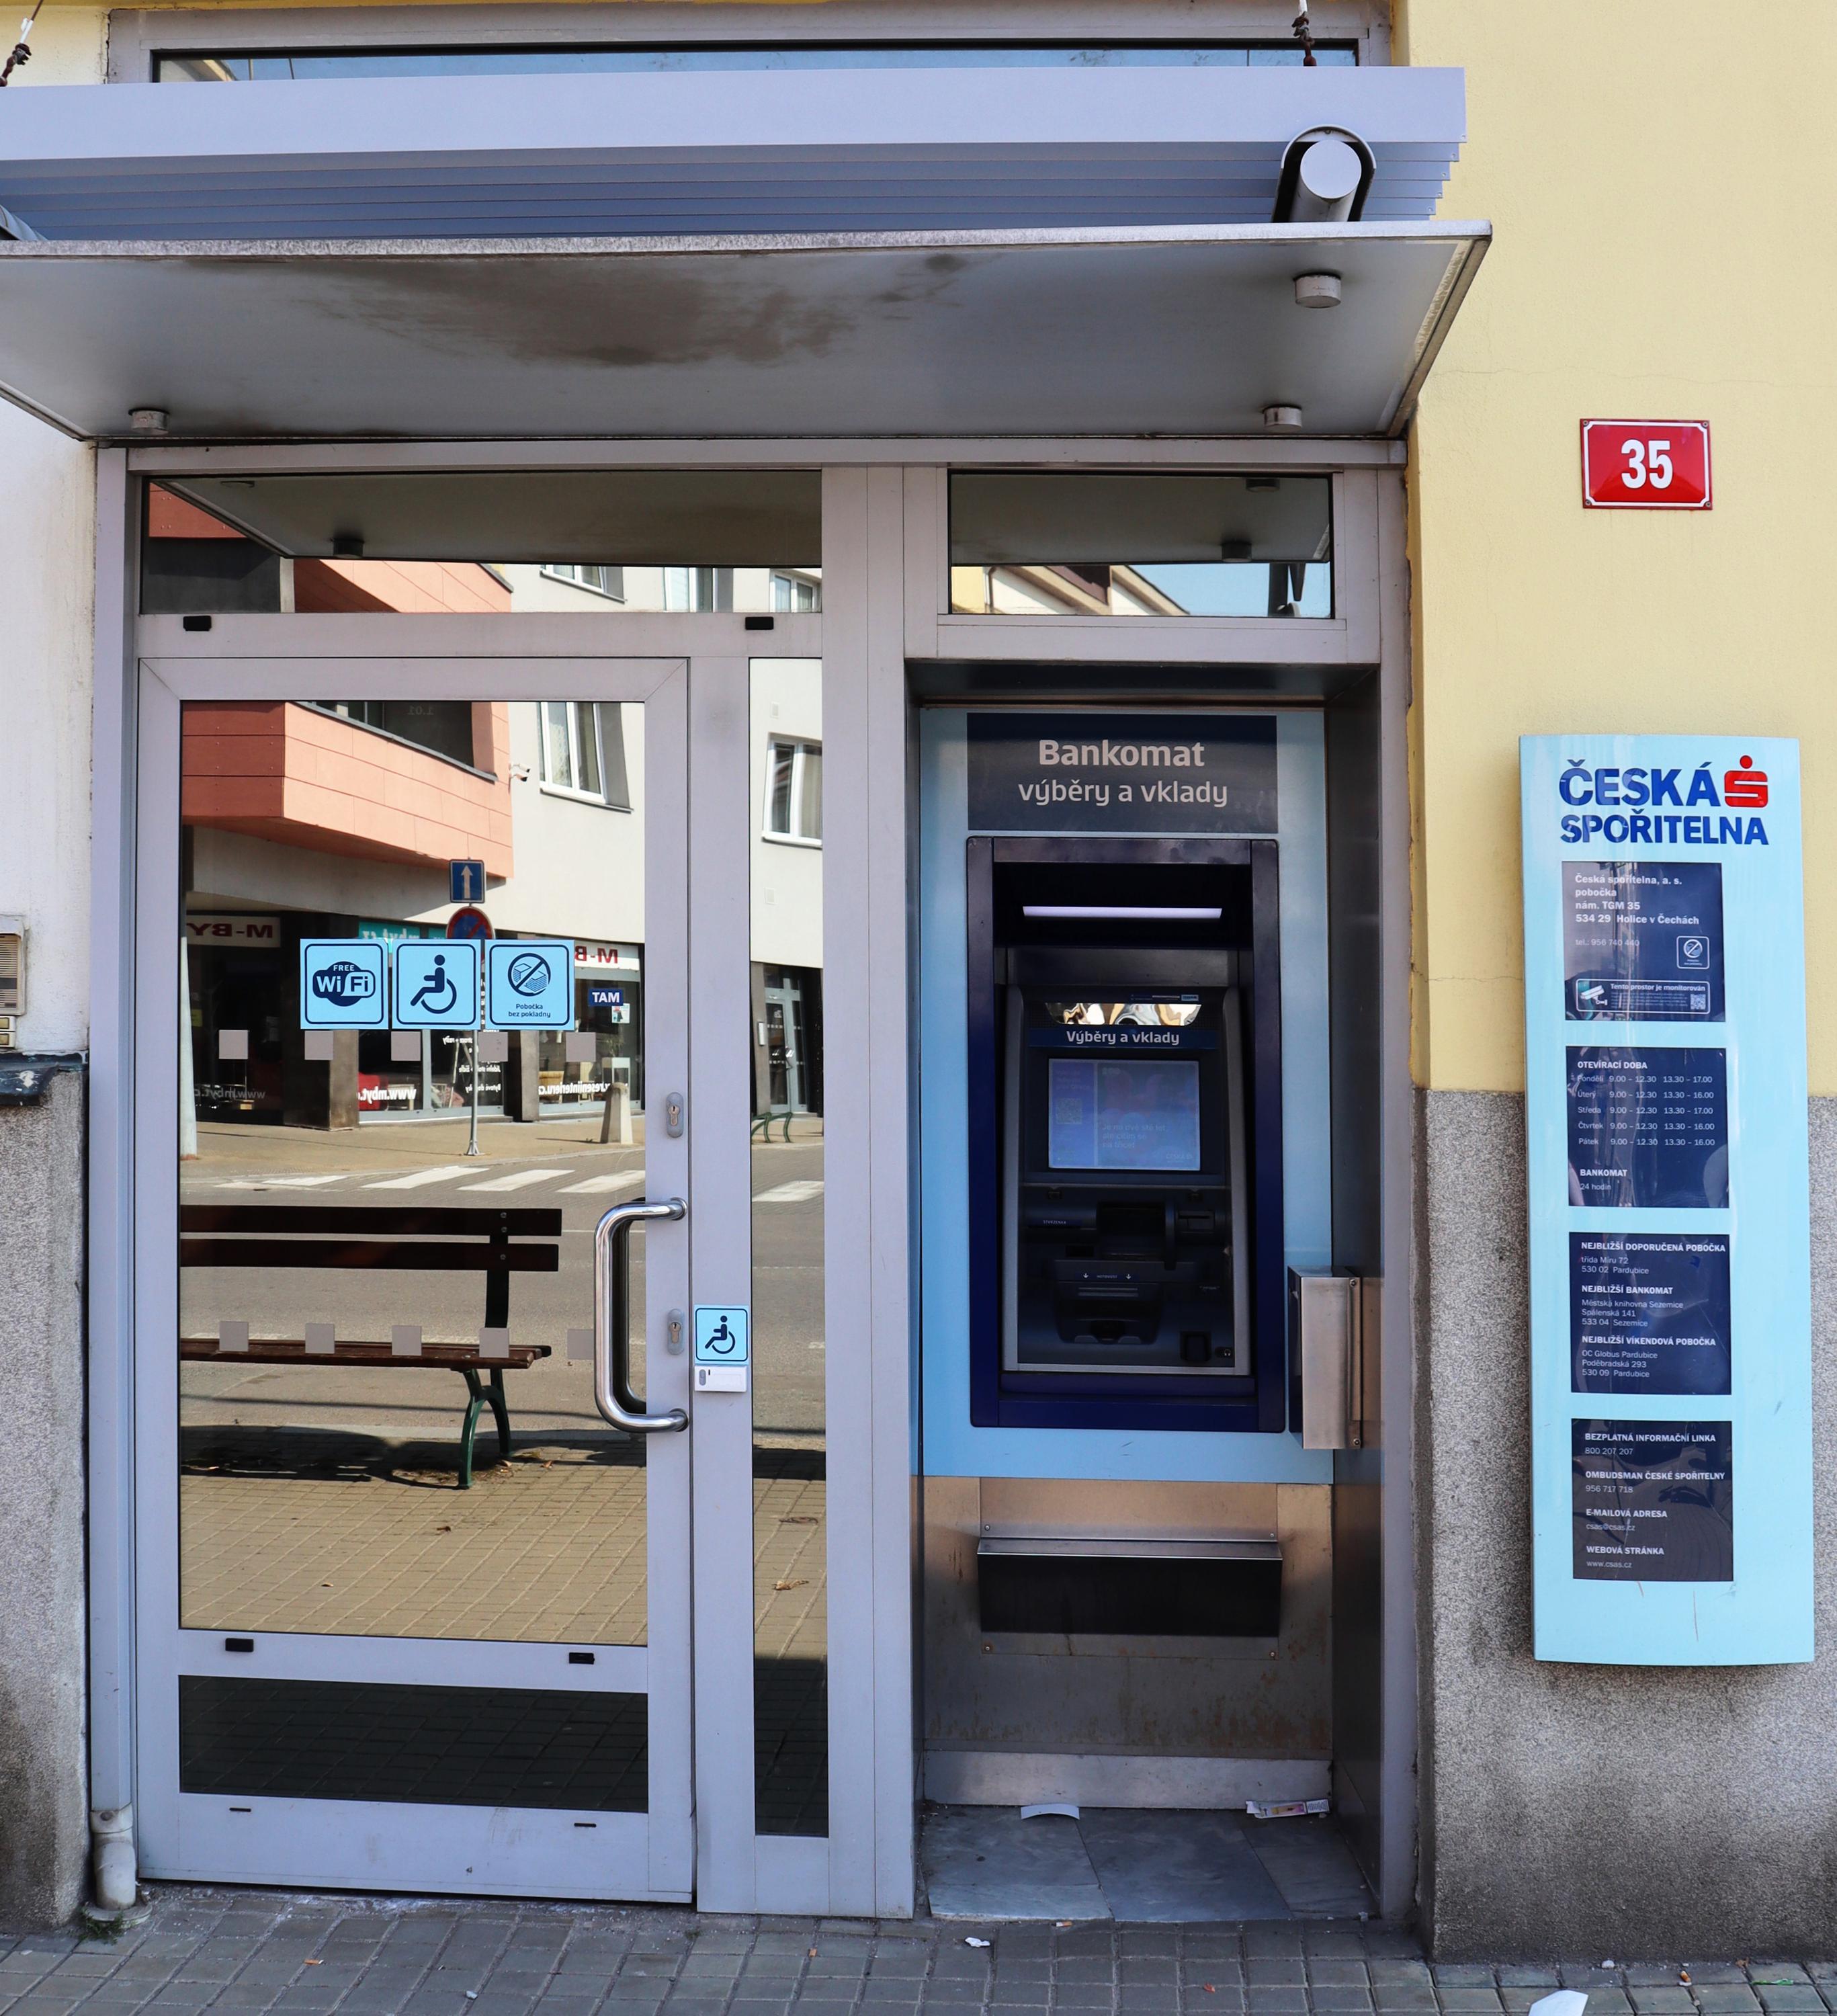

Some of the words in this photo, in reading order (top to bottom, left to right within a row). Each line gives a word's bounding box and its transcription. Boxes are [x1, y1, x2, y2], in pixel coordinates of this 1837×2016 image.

[1621, 439, 1673, 489] 35
[1039, 740, 1205, 767] Bankomat
[1559, 759, 1721, 806] ČESKÁ
[1018, 780, 1110, 806] výběry
[1118, 786, 1133, 802] a
[1140, 781, 1228, 808] vklady
[1560, 808, 1769, 845] SPOŘITELNA
[1575, 873, 1605, 884] Česká
[1608, 874, 1660, 887] spořitelna,
[1575, 888, 1617, 898] pobočka
[1575, 901, 1600, 910] nám.
[1602, 901, 1625, 910] TGM
[1627, 902, 1641, 910] 35
[1575, 915, 1595, 923] 534
[1598, 915, 1611, 923] 29
[1617, 915, 1648, 923] Holice
[1658, 913, 1699, 925] Čechách
[1630, 984, 1654, 992] prostor
[1656, 984, 1662, 992] je
[1664, 984, 1705, 992] monitorován
[593, 992, 620, 1003] TAM
[1066, 1030, 1116, 1044] Výběry
[1120, 1034, 1128, 1042] a
[1132, 1031, 1180, 1046] vklady
[1578, 1060, 1621, 1068] OTEVÍRACÍ
[1578, 1091, 1596, 1099] Úterý
[1578, 1121, 1604, 1129] Čtvrtek
[1581, 1241, 1624, 1250] NEJBLIŽŠÍ
[1625, 1242, 1684, 1252] DOPORUČENÁ
[1685, 1243, 1725, 1252] POBOČKA
[1613, 1266, 1650, 1274] Pardubice
[1582, 1284, 1624, 1293] NEJBLIŽŠÍ
[1626, 1286, 1673, 1294] BANKOMAT
[1582, 1299, 1613, 1308] Městská
[1614, 1300, 1648, 1308] knihovna
[1581, 1308, 1620, 1317] Spálenská
[1582, 1335, 1624, 1344] NEJBLIŽŠÍ
[1626, 1336, 1674, 1345] VÍKENDOVÁ
[1676, 1337, 1716, 1346] POBOČKA
[1622, 1351, 1658, 1359] Pardubice
[1582, 1359, 1629, 1368] Poděbradská
[1614, 1370, 1650, 1378] Pardubice
[1585, 1433, 1633, 1441] BEZPLATNÁ
[1635, 1433, 1689, 1442] INFORMAČNÍ
[1586, 1471, 1643, 1480] OMBUDSMAN
[1645, 1470, 1672, 1480] ČESKÉ
[1674, 1470, 1725, 1480] SPOŘITELNY
[1586, 1508, 1631, 1517] E-MAILOVÁ
[1586, 1545, 1623, 1554] WEBOVÁ
[1625, 1546, 1665, 1555] STRÁNKA
